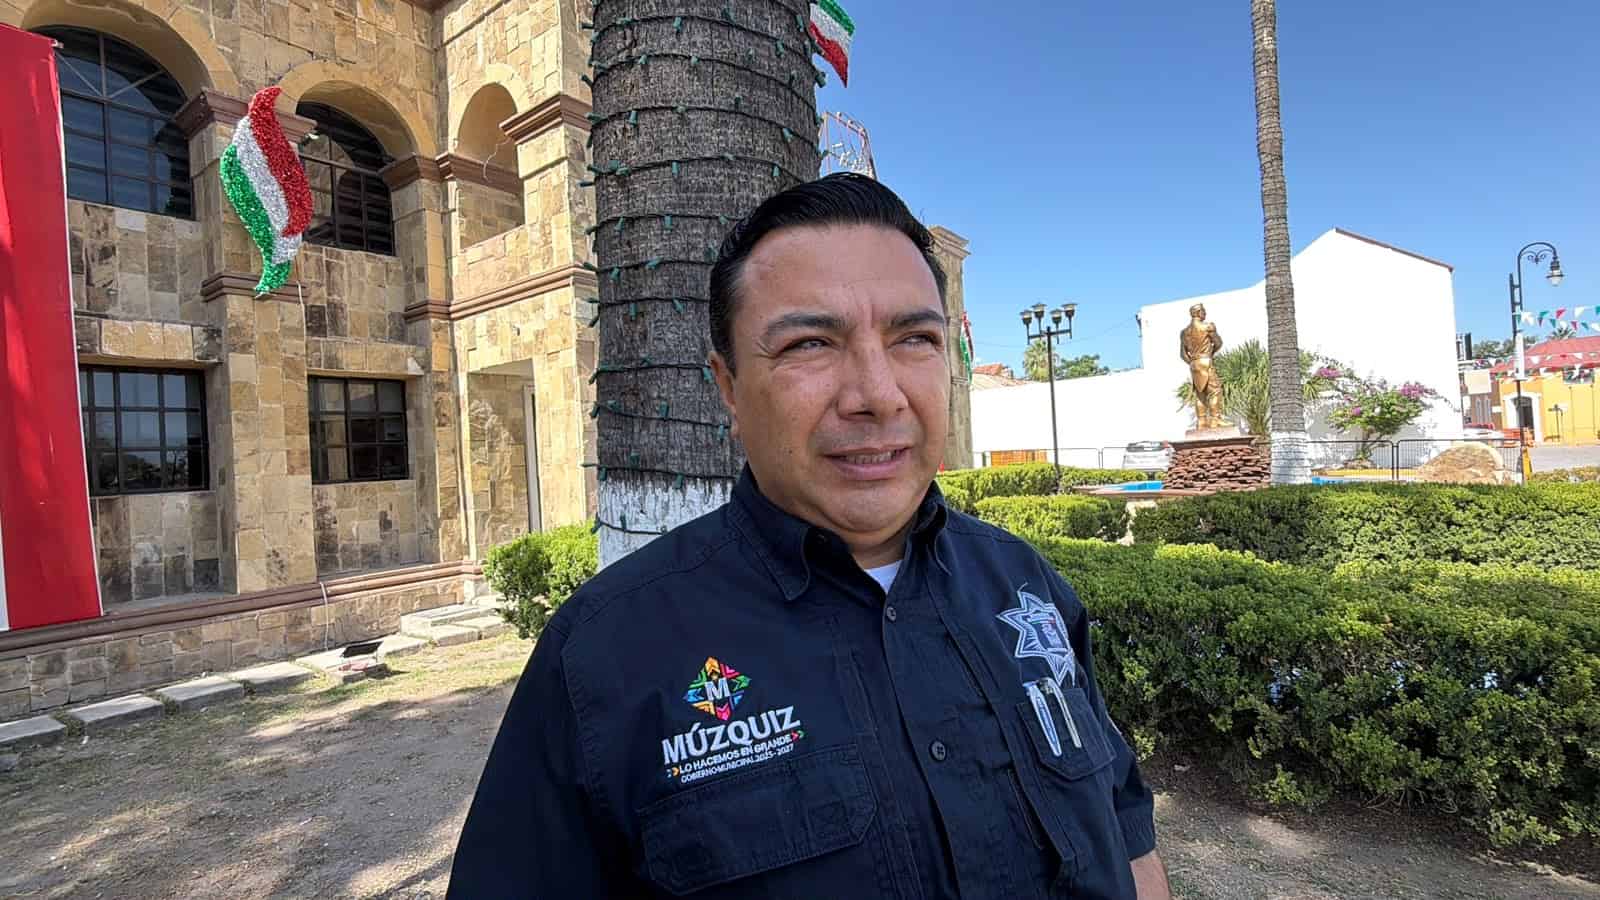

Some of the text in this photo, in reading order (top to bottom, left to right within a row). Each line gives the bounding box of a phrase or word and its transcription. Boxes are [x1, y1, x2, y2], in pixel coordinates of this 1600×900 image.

[704, 677, 731, 700] M
[661, 705, 801, 766] MÚZQUIZ
[679, 733, 793, 774] LO HACEMOS EN GRANDE
